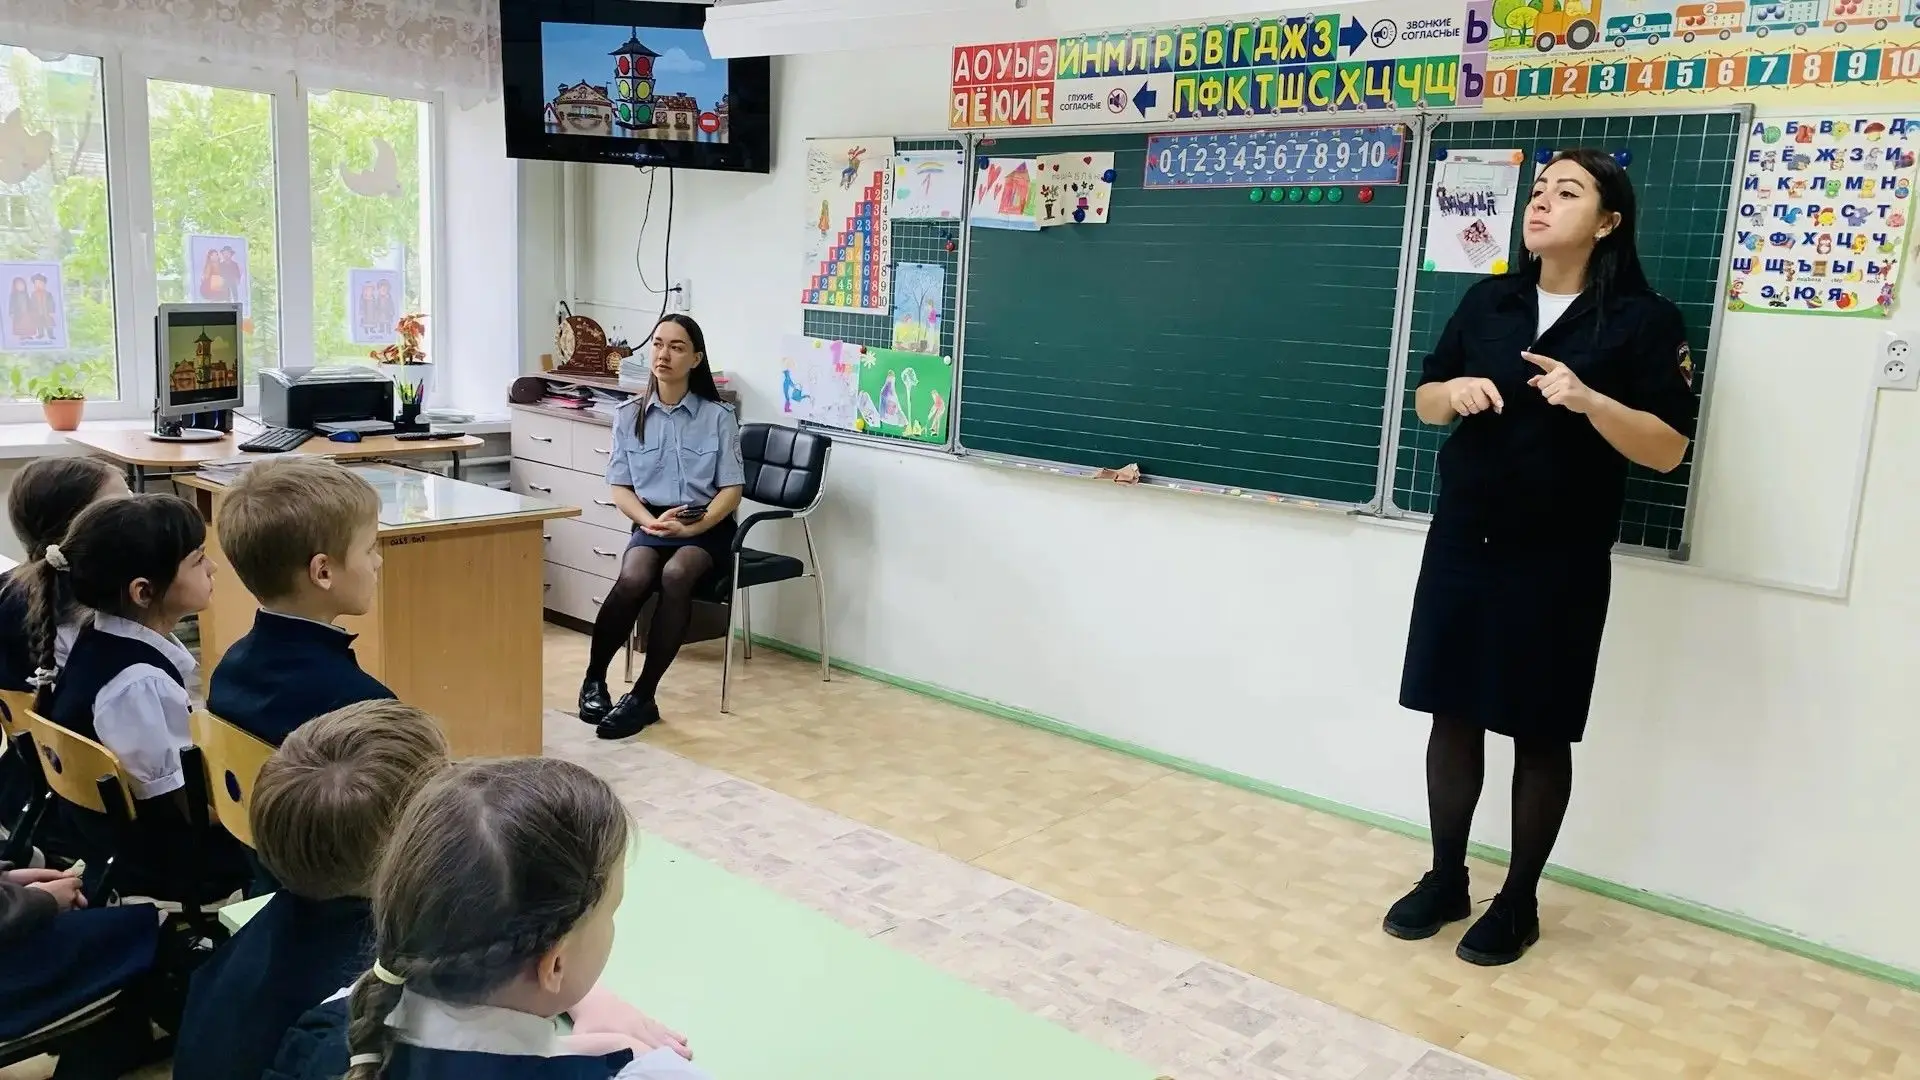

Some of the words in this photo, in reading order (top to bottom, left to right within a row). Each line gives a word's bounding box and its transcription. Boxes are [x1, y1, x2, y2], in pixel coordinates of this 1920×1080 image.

[1707, 4, 1714, 13] 2
[1406, 18, 1451, 30] ЗВОНКИЕ
[1636, 14, 1642, 25] 1
[1466, 10, 1488, 44] Ь
[1401, 28, 1460, 40] СОГЛАСНЫЕ
[1493, 72, 1507, 95] 0
[1529, 71, 1539, 93] 1
[1562, 68, 1578, 92] 2
[1600, 66, 1615, 90] 3
[1637, 64, 1653, 88] 4
[1676, 62, 1695, 87] 5
[1718, 60, 1735, 84] 6
[1760, 57, 1778, 83] 7
[1803, 54, 1821, 80] 8
[1847, 52, 1867, 79] 9
[1889, 49, 1920, 77] 10
[1463, 63, 1483, 97] Ъ
[1068, 93, 1093, 101] ГЛУХИЕ
[1060, 102, 1101, 111] СОГЛАСНЫЕ
[1753, 122, 1764, 135] А
[1786, 121, 1798, 134] Б
[1820, 120, 1832, 133] В
[1854, 119, 1867, 132] Г
[1889, 118, 1906, 135] Д
[1160, 149, 1172, 173] 0
[1178, 148, 1187, 172] 1
[1194, 147, 1207, 172] 2
[1214, 146, 1226, 171] 3
[1233, 145, 1247, 170] 4
[1253, 145, 1267, 170] 5
[1274, 144, 1287, 169] 6
[1295, 143, 1309, 169] 7
[1314, 143, 1328, 169] 8
[1336, 142, 1350, 168] 9
[1358, 140, 1385, 168] 10
[1749, 150, 1761, 162] Е
[1782, 146, 1794, 162] Ё
[1815, 149, 1837, 161] Ж
[1850, 148, 1863, 160] З
[1885, 147, 1901, 160] И
[886, 158, 890, 169] 1
[884, 174, 890, 185] 2
[1744, 174, 1759, 190] Й
[1777, 177, 1792, 190] К
[1810, 177, 1826, 190] Л
[1845, 176, 1864, 189] М
[1881, 176, 1897, 189] Н
[867, 190, 871, 200] 1
[875, 189, 881, 200] 2
[883, 189, 889, 200] 3
[858, 204, 862, 215] 1
[874, 205, 879, 215] 3
[882, 205, 888, 215] 4
[1740, 204, 1754, 217] О
[1773, 204, 1788, 217] П
[1807, 204, 1820, 217] Р
[1841, 204, 1855, 217] С
[1877, 205, 1890, 218] Т
[849, 219, 854, 230] 1
[857, 220, 863, 231] 2
[865, 220, 871, 230] 3
[874, 220, 879, 231] 4
[882, 220, 888, 231] 5
[840, 235, 845, 245] 1
[848, 235, 854, 245] 2
[865, 236, 870, 246] 4
[873, 236, 879, 246] 5
[882, 235, 888, 246] 6
[1737, 231, 1751, 243] У
[1769, 232, 1787, 243] Ф
[1802, 232, 1817, 245] Х
[1837, 232, 1852, 249] Ц
[1872, 233, 1886, 245] Ч
[832, 250, 836, 260] 1
[840, 249, 845, 260] 2
[865, 250, 870, 260] 5
[873, 251, 879, 260] 6
[882, 251, 887, 261] 7
[823, 264, 827, 275] 1
[831, 264, 836, 275] 2
[864, 265, 869, 276] 6
[873, 265, 878, 276] 7
[881, 265, 887, 276] 8
[1732, 258, 1752, 271] Ш
[1765, 259, 1784, 274] Щ
[1798, 259, 1811, 272] Ъ
[1832, 261, 1854, 273] Ы
[1867, 261, 1880, 274] Ь
[814, 279, 819, 289] 1
[822, 278, 827, 289] 2
[838, 279, 844, 290] 4
[847, 280, 852, 290] 5
[864, 281, 869, 291] 7
[872, 281, 877, 291] 8
[881, 281, 887, 292] 9
[1761, 285, 1774, 298] Э
[1794, 286, 1815, 300] Ю
[1828, 288, 1842, 301] Я
[812, 292, 818, 302] 2
[846, 294, 852, 304] 6
[863, 295, 868, 305] 8
[872, 295, 877, 306] 9
[879, 296, 887, 307] 10
